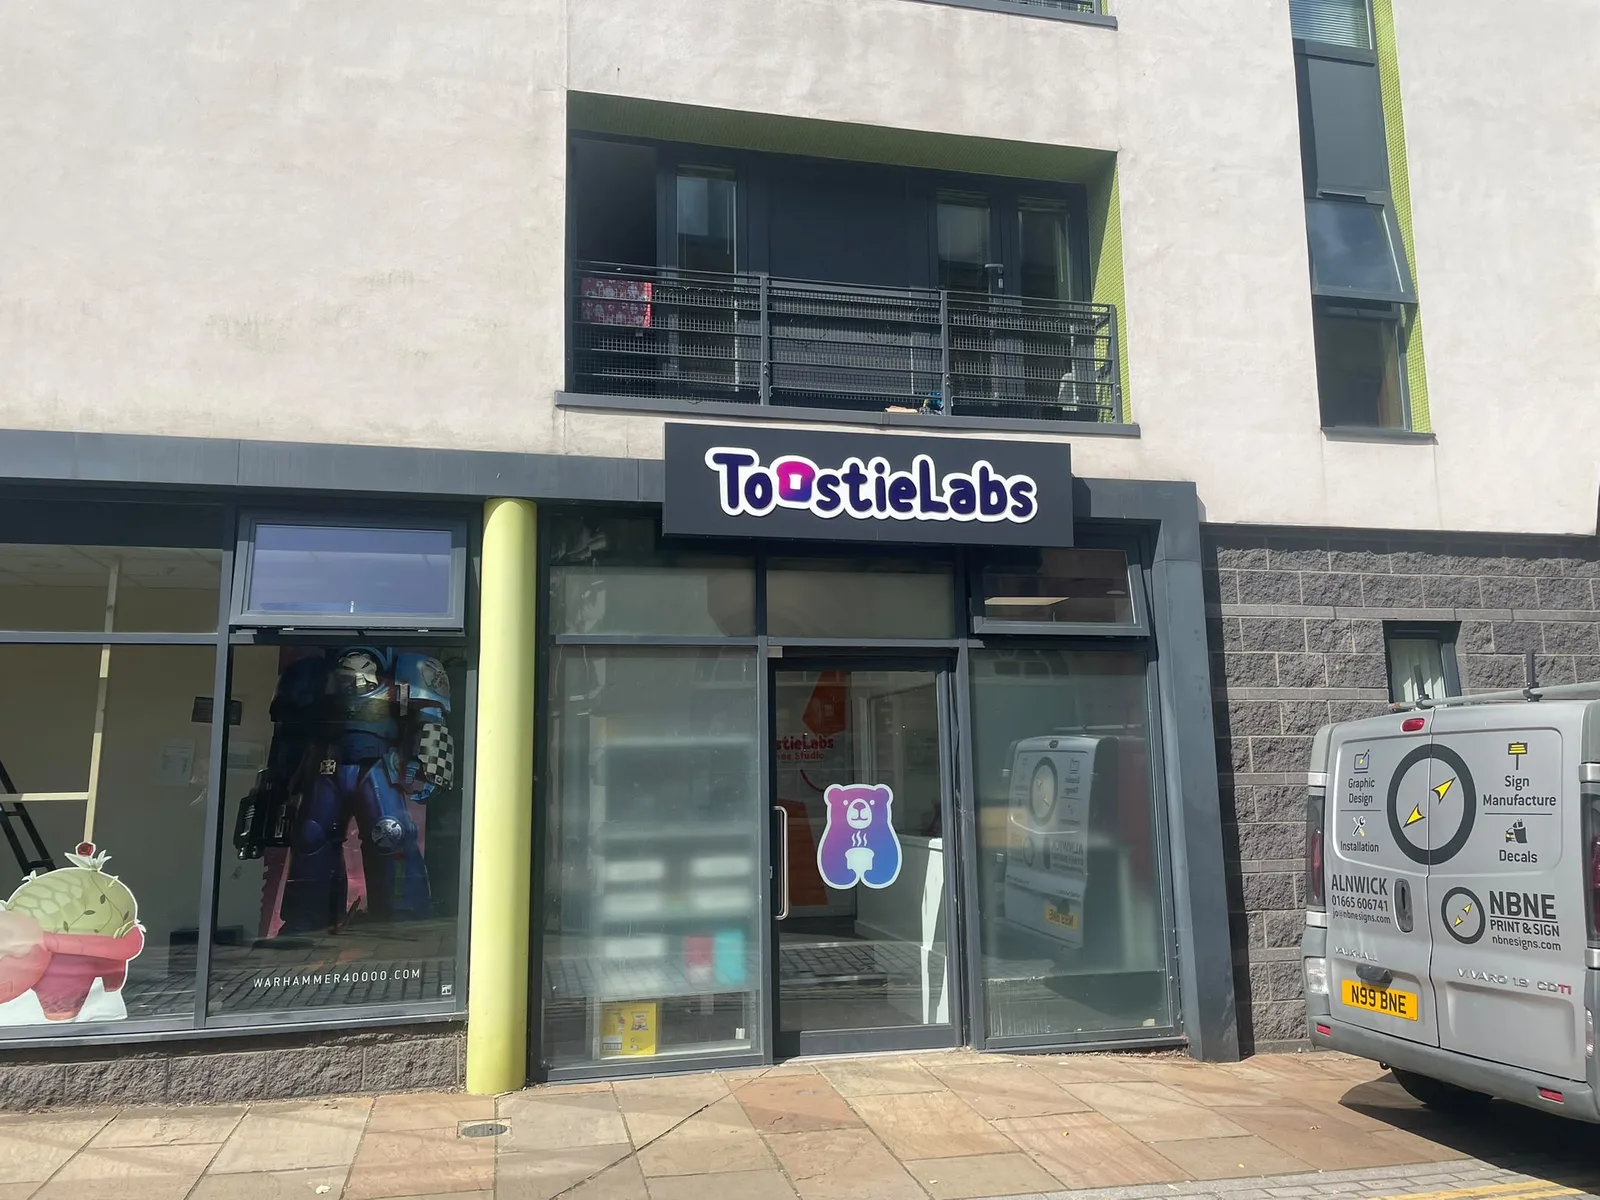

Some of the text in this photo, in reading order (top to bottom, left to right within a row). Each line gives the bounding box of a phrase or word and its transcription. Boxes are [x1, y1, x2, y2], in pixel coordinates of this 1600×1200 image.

[776, 735, 834, 750] stieLabs
[1348, 777, 1376, 791] Graphic
[1504, 775, 1530, 791] Sign
[1348, 792, 1373, 806] Design
[1483, 793, 1557, 806] Manufacture
[1340, 840, 1380, 852] Installation
[1499, 849, 1538, 863] Decals
[1331, 874, 1388, 896] ALNWICK
[1331, 894, 1388, 912] 01665 606741
[1489, 890, 1557, 919] NBNE
[1490, 919, 1560, 937] PRINT & SIGN
[1492, 935, 1561, 951] nbnesigns.com
[253, 968, 421, 988] WARHAMMER40000.COM
[1457, 968, 1509, 984] VIVARO
[1351, 985, 1407, 1014] N99 BNE
